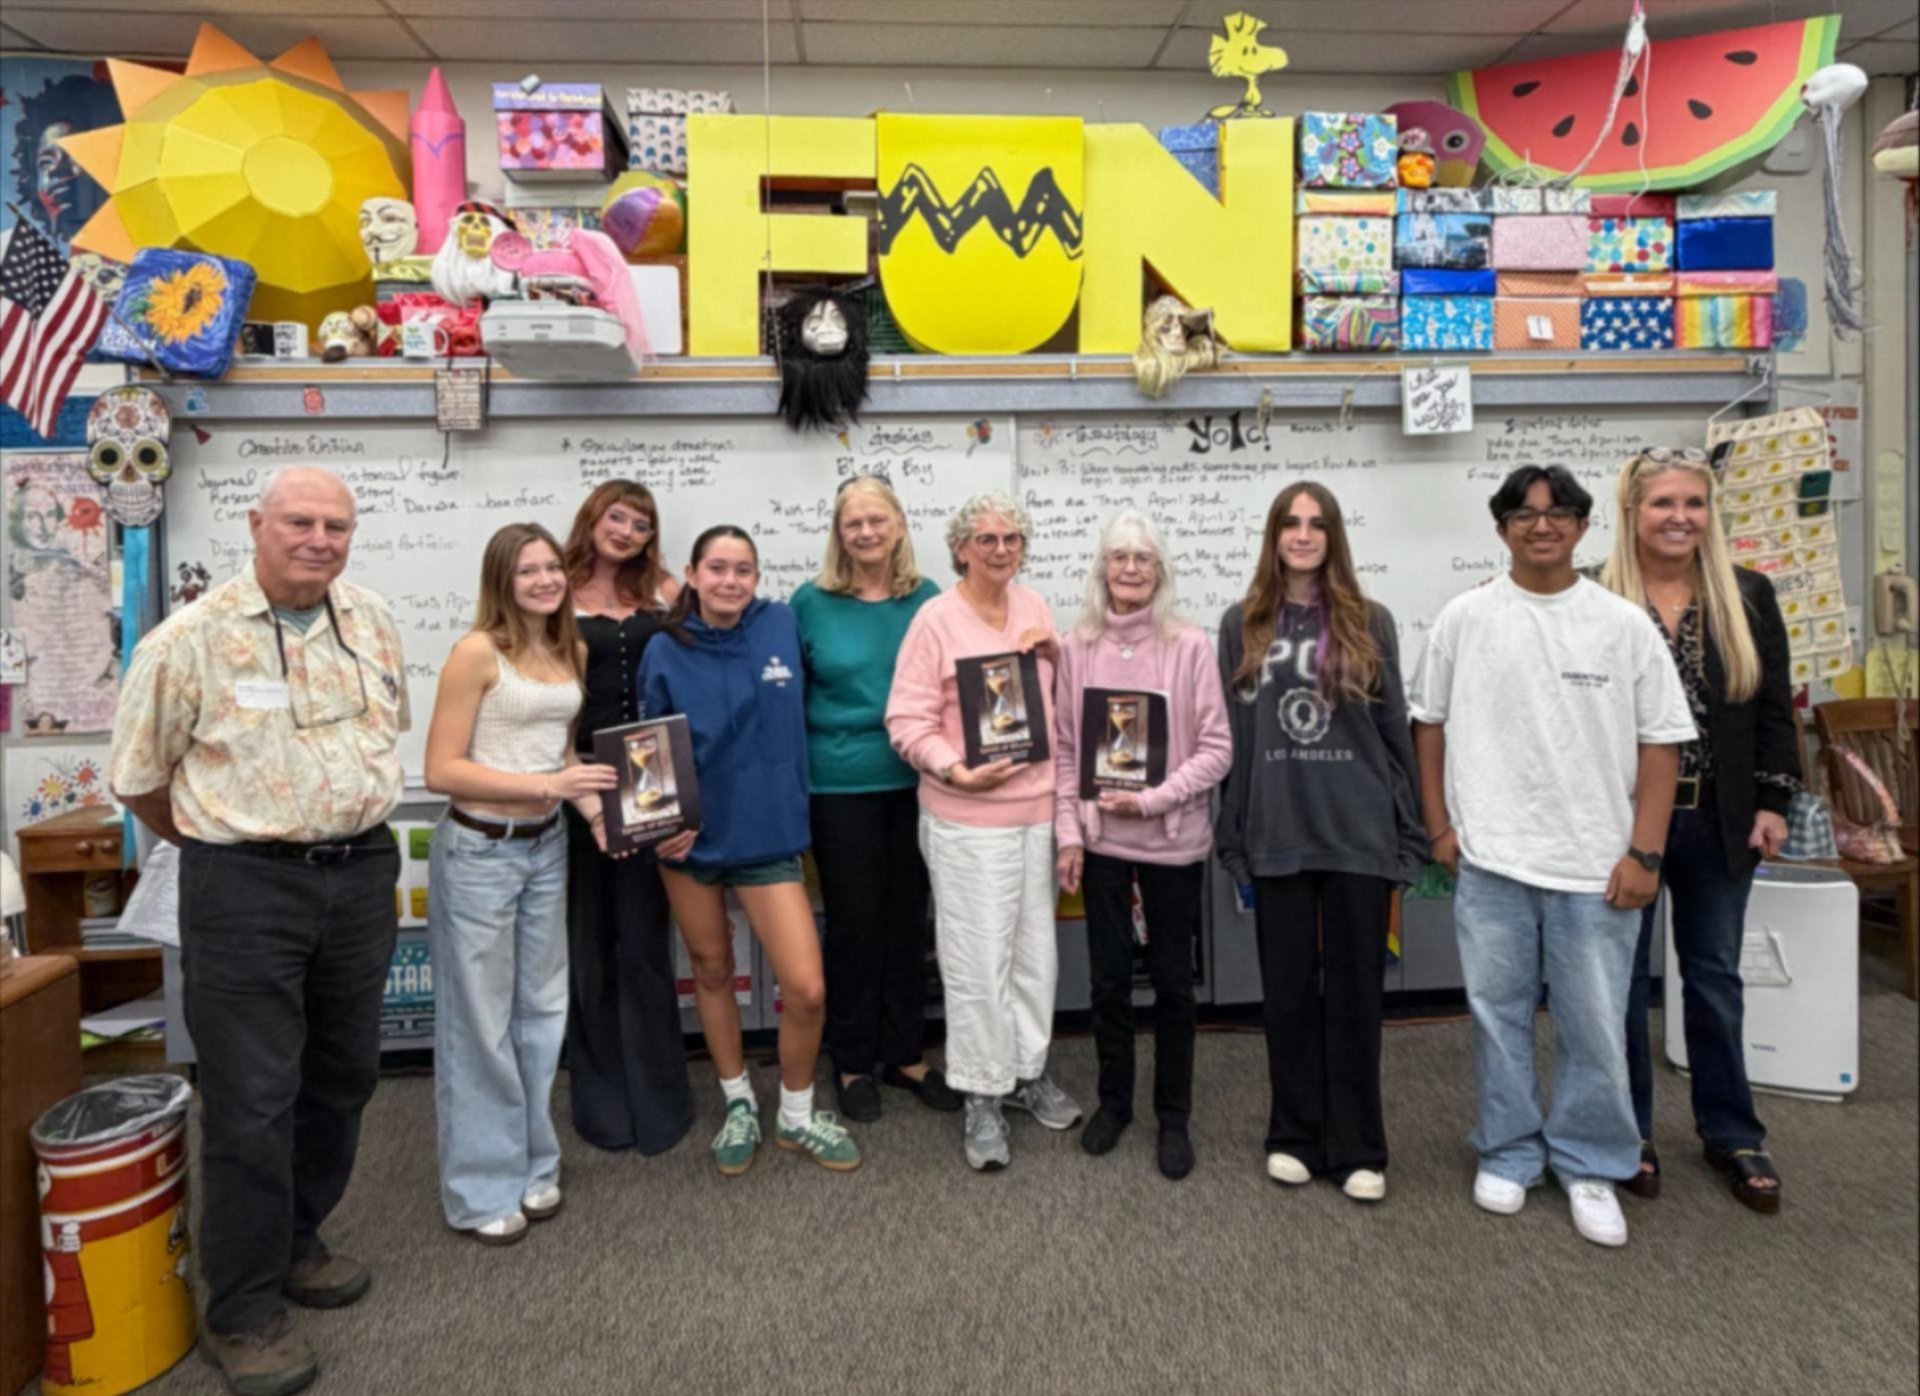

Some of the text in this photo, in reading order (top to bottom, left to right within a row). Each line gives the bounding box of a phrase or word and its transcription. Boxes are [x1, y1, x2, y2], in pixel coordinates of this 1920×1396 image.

[687, 113, 1293, 357] FUN
[198, 467, 257, 490] Journal
[902, 458, 935, 486] Boy
[1019, 463, 1050, 478] Unit
[1080, 474, 1112, 489] begin
[1119, 476, 1152, 488] again
[1188, 509, 1223, 527] April
[415, 618, 442, 631] due
[1265, 749, 1354, 762] LOS ANGELES
